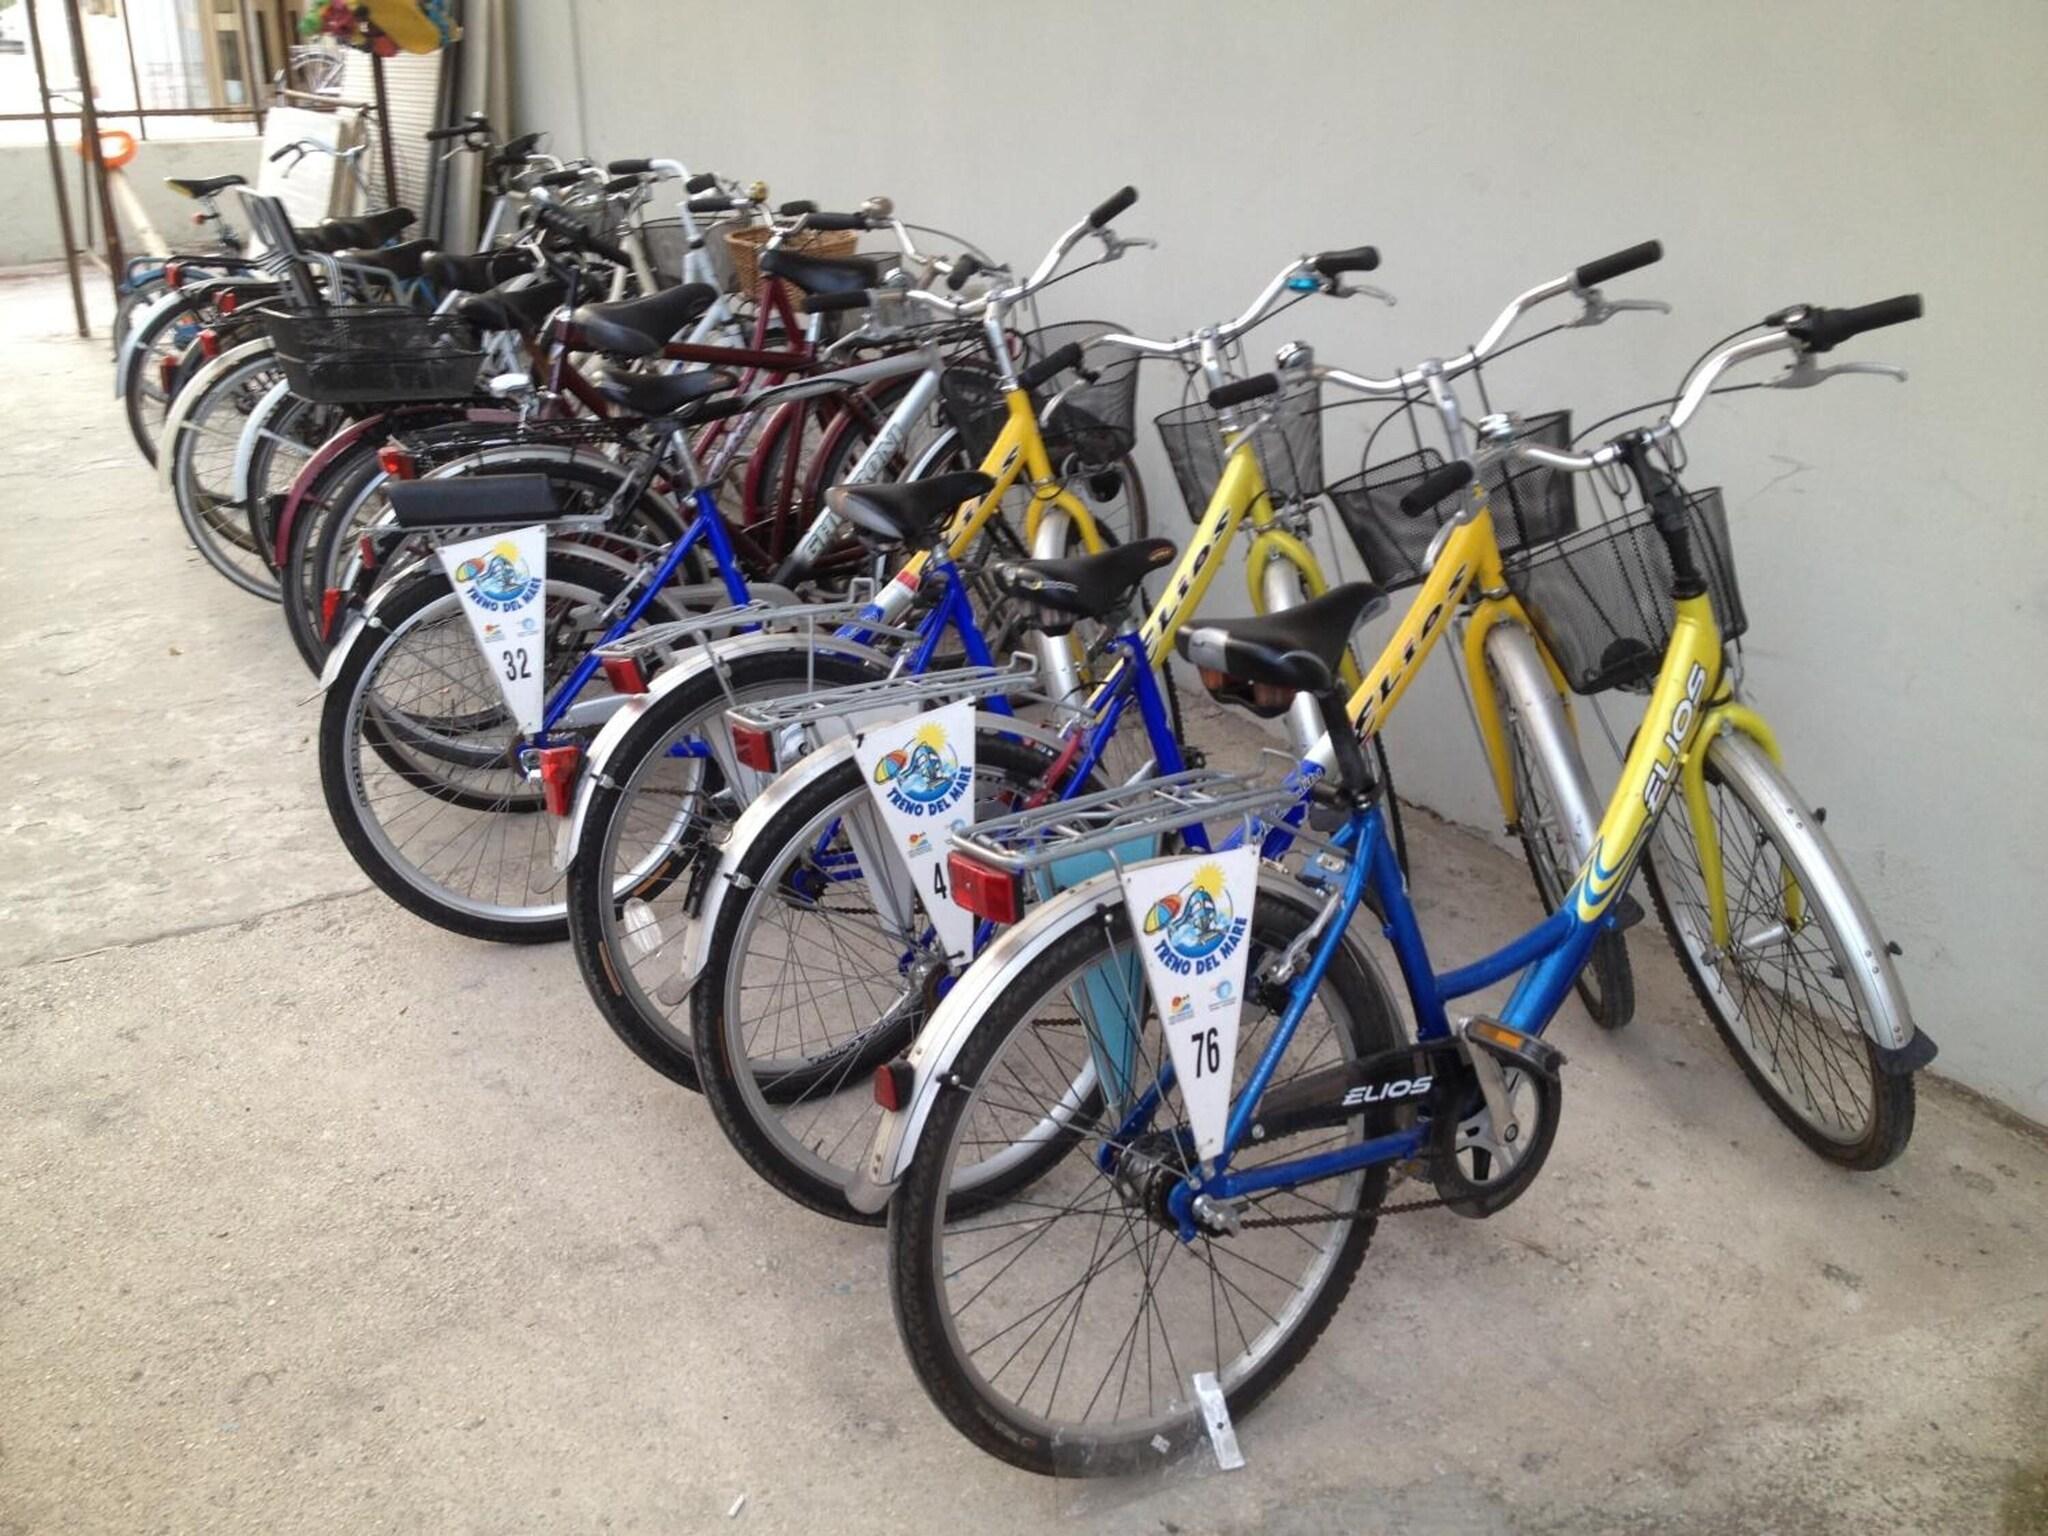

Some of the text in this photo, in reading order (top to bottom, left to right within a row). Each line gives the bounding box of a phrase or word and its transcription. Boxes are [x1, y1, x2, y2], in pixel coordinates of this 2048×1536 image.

[466, 577, 542, 612] TRENO DEL MARE
[503, 647, 531, 681] 32
[1643, 663, 1706, 814] ELIOS
[886, 766, 972, 817] TRENO DEL MARE
[1154, 917, 1248, 976] TRENO DEL MARE
[1191, 1027, 1220, 1079] 76
[1342, 1076, 1433, 1106] ELIOS
